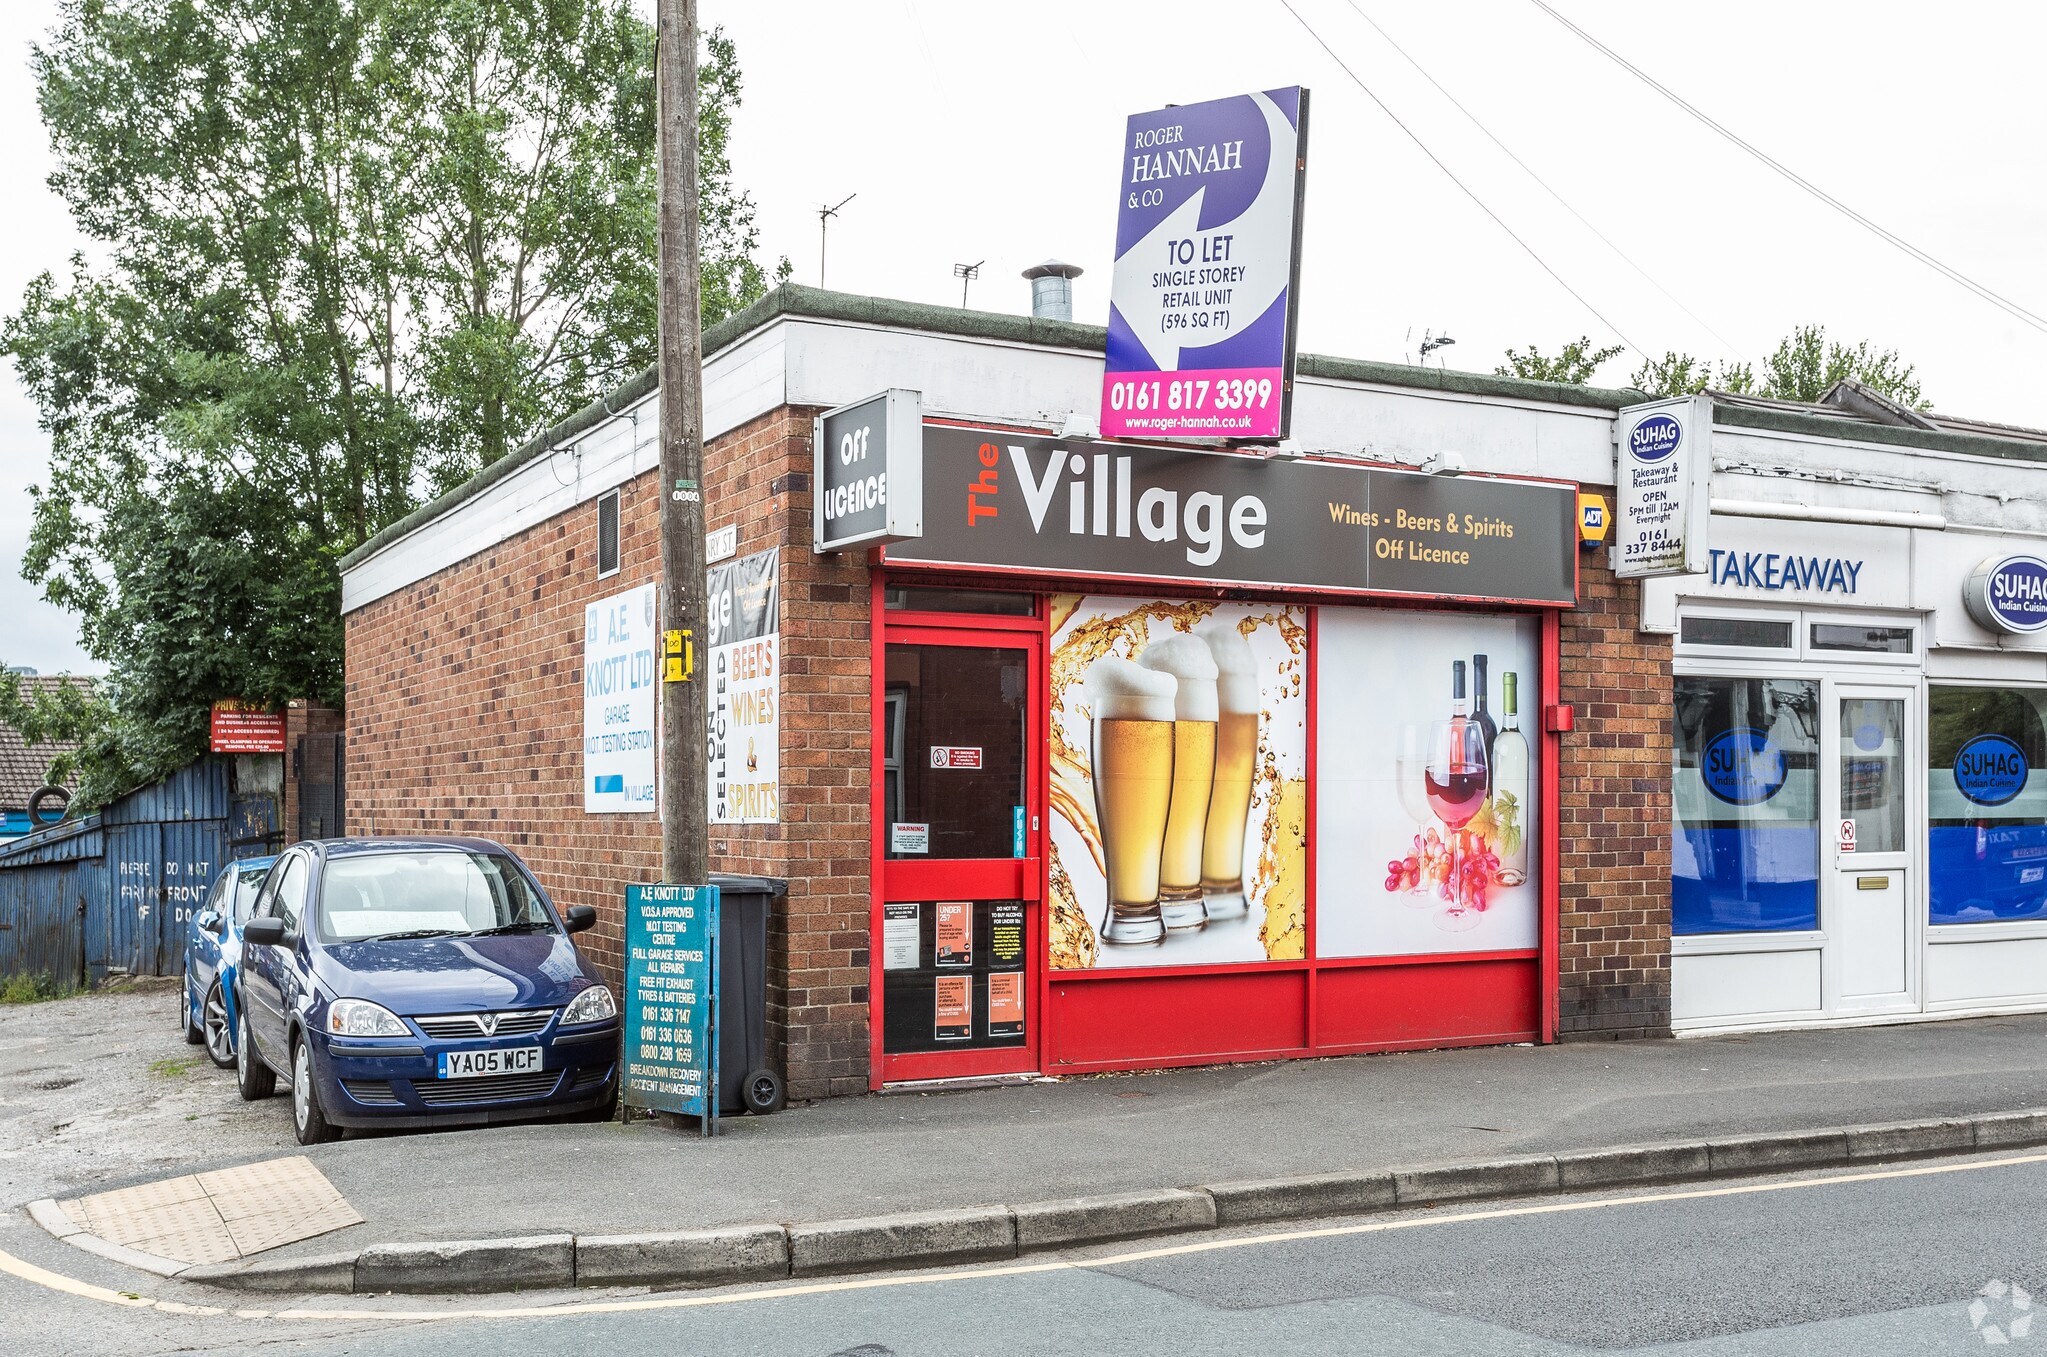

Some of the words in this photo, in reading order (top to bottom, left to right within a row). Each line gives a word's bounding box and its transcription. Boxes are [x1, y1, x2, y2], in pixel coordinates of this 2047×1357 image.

[1134, 125, 1184, 149] ROGER
[1130, 140, 1244, 184] HANNAH
[1128, 192, 1139, 209] &
[1141, 188, 1163, 207] CO
[1168, 238, 1195, 265] TO
[1202, 235, 1234, 262] LET
[1152, 270, 1196, 288] SINGLE
[1198, 265, 1246, 285] STOREY
[1162, 291, 1200, 308] RETAIL
[1204, 288, 1233, 306] UNIT
[1161, 313, 1187, 333] (596
[1191, 311, 1209, 328] SQ
[1213, 310, 1230, 330] FT)
[1110, 381, 1161, 411] 0161
[1167, 380, 1211, 410] 817
[1214, 378, 1273, 410] 3399
[1125, 414, 1252, 431] www.roger-hannah.co.uk
[1633, 423, 1676, 446] SUHAG
[1636, 445, 1653, 453] Indian
[1653, 442, 1673, 451] Cuisine
[1632, 466, 1670, 479] Takeaway
[1672, 462, 1679, 473] &
[1632, 474, 1677, 489] Restaurant
[968, 442, 999, 527] The
[1007, 445, 1268, 567] Village
[1642, 490, 1667, 503] OPEN
[1585, 510, 1602, 525] ADT
[1629, 506, 1644, 517] 5PM
[1645, 503, 1657, 514] till
[1660, 501, 1679, 513] 12AM
[1328, 502, 1379, 527] Wines
[1396, 508, 1441, 532] Beers
[1446, 512, 1459, 534] &
[1464, 514, 1514, 540] Spirits
[1636, 512, 1671, 525] Everynight
[1640, 528, 1667, 542] 0161
[706, 537, 720, 557] NRY
[1375, 537, 1404, 559] Off
[1409, 540, 1470, 565] Licence
[1625, 542, 1647, 555] 337
[1650, 538, 1681, 552] 8444
[1709, 549, 1864, 594] TAKEAWAY
[1998, 599, 2022, 611] Indian
[608, 604, 630, 645] A.E.
[709, 589, 731, 645] ge
[732, 640, 773, 682] BEERS
[586, 654, 627, 698] KNOTT
[630, 648, 653, 690] LTD
[604, 704, 630, 725] GARAGE
[730, 686, 774, 728] WINES
[601, 732, 627, 753] TESTING
[627, 730, 653, 750] STATION
[707, 711, 716, 763] ON
[717, 651, 726, 819] SELECTED
[746, 736, 758, 773] &
[1962, 753, 2019, 777] SUHAG
[1966, 778, 1988, 788] Indian
[1990, 777, 2016, 788] Cuisine
[624, 786, 630, 801] IN
[630, 784, 654, 801] VILLAGE
[728, 781, 777, 820] SPIRITS
[120, 862, 150, 876] PLEASE
[166, 862, 179, 875] DO
[654, 887, 680, 900] KNOTT
[681, 887, 695, 901] LTD
[662, 907, 694, 918] APPROVED
[940, 906, 961, 914] UNDER
[940, 913, 951, 922] 25?
[662, 921, 686, 932] TESTING
[652, 934, 676, 945] CENTRE
[632, 948, 647, 959] FULL
[648, 948, 673, 960] GARAGE
[674, 949, 704, 962] SERVICES
[647, 962, 659, 973] ALL
[660, 963, 685, 974] REPAIRS
[639, 976, 655, 988] FREE
[656, 977, 665, 988] FIT
[666, 978, 694, 990] EXHAUST
[637, 989, 657, 1002] TYRES
[659, 991, 663, 1002] &
[664, 991, 696, 1005] BATTERIES
[642, 1006, 658, 1021] 0161
[660, 1007, 674, 1023] 336
[675, 1009, 691, 1023] 7147
[641, 1026, 657, 1041] 0161
[658, 1027, 672, 1042] 336
[673, 1029, 692, 1044] 0636
[450, 1053, 498, 1074] YA05
[504, 1049, 538, 1070] WCF
[640, 1045, 658, 1059] 0800
[660, 1046, 673, 1061] 298
[630, 1064, 669, 1078] BREAKDOWN
[669, 1068, 702, 1082] RECOVERY
[630, 1078, 658, 1092] ACCIDENT
[659, 1081, 702, 1097] MANAGEMENT
